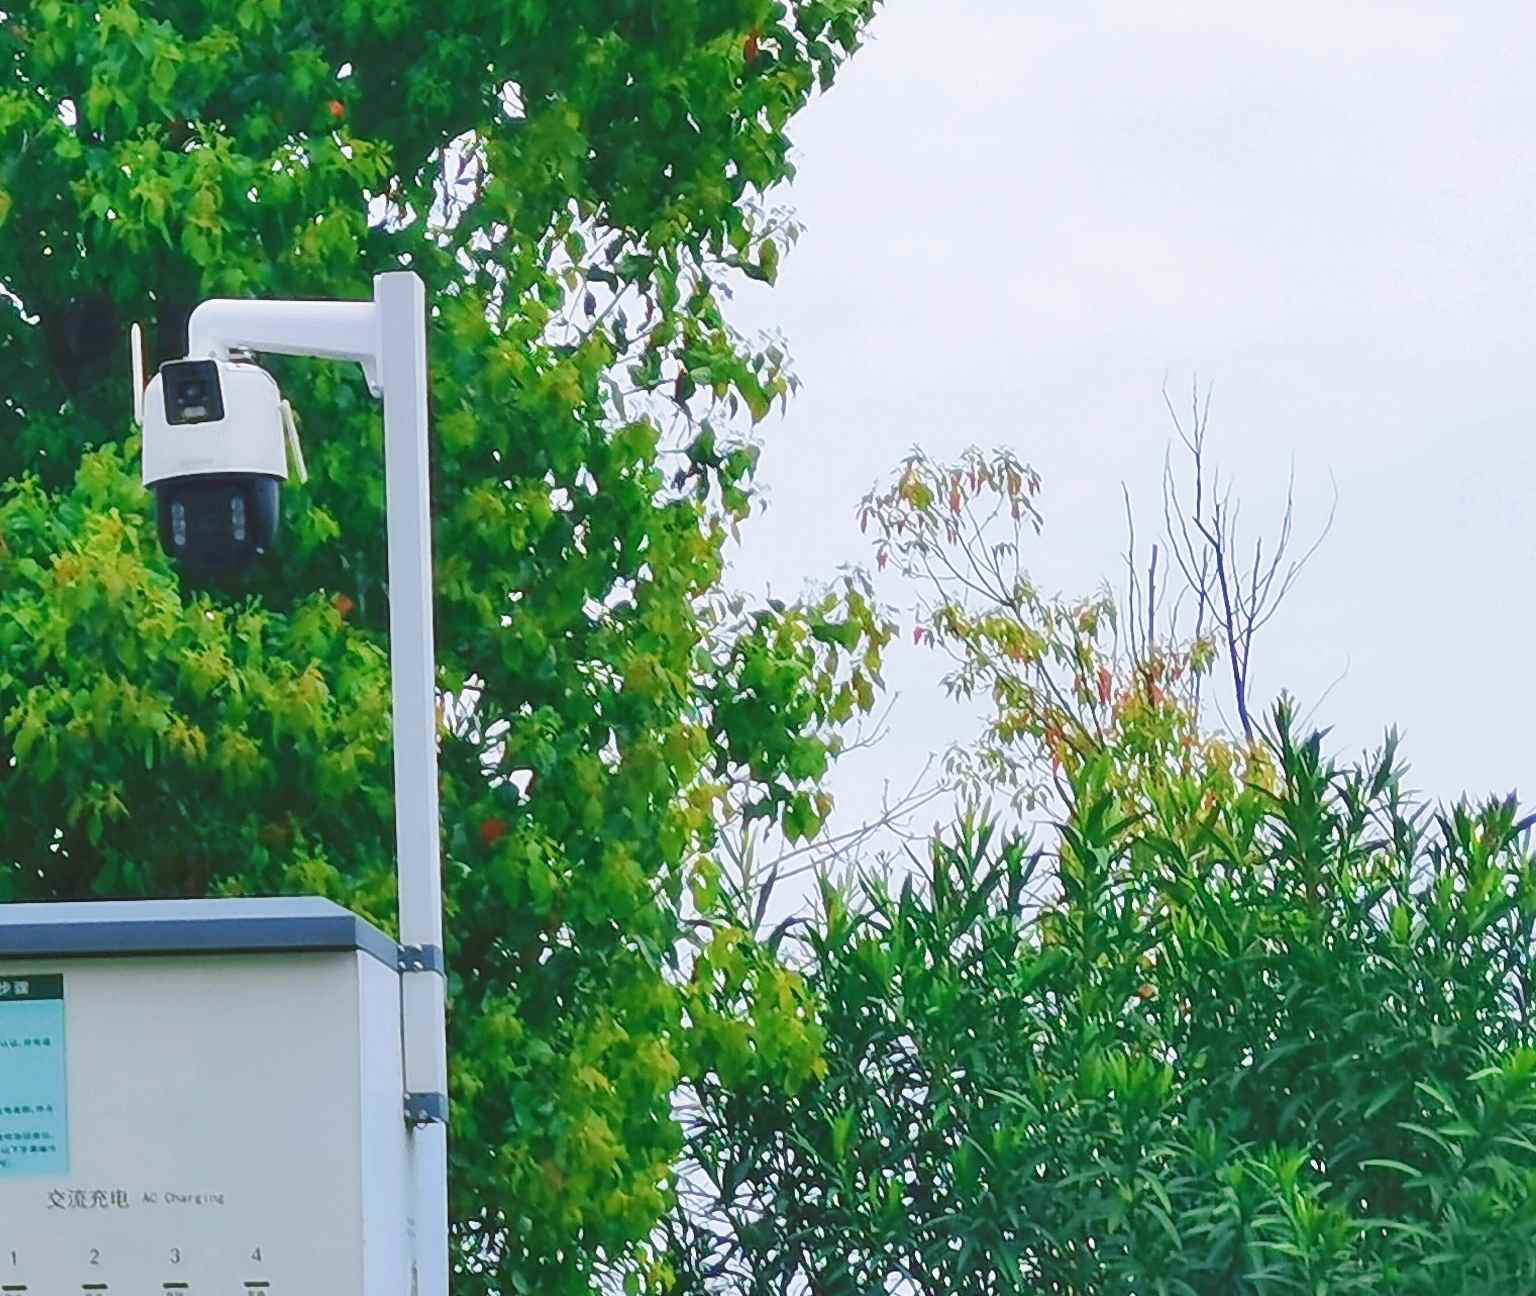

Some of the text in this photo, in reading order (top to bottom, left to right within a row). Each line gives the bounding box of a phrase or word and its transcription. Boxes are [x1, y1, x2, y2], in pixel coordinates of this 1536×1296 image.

[48, 1188, 224, 1209] 交流充电 AC Charging
[10, 1251, 18, 1265] 1
[89, 1249, 101, 1265] 2
[169, 1248, 181, 1264] 3
[250, 1248, 262, 1263] 4
